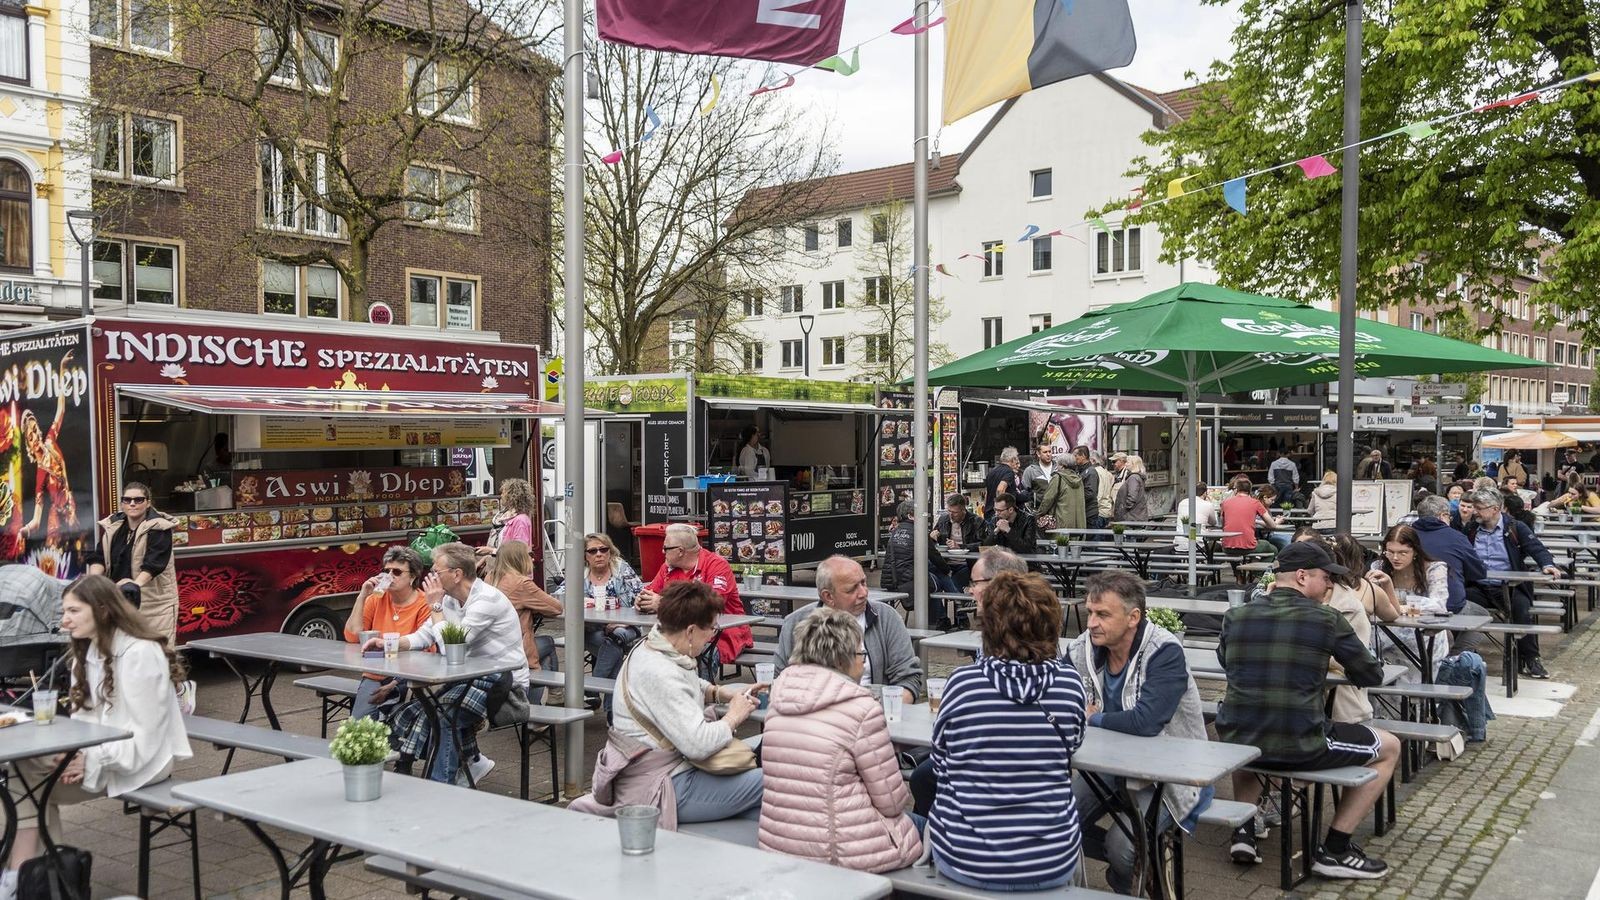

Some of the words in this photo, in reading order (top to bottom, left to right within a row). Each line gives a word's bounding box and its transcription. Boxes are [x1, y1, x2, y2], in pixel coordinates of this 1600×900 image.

[12, 331, 80, 353] SPEZIALITÄTEN
[104, 331, 307, 367] INDISCHE
[318, 347, 529, 377] SPEZIALITÄTEN
[25, 360, 88, 407] Dhep
[635, 385, 678, 403] FOODS
[266, 474, 340, 498] Aswi
[380, 472, 445, 494] Dhep
[791, 532, 815, 552] FOOD
[834, 539, 868, 549] GESCHMACK
[845, 532, 858, 540] 100%
